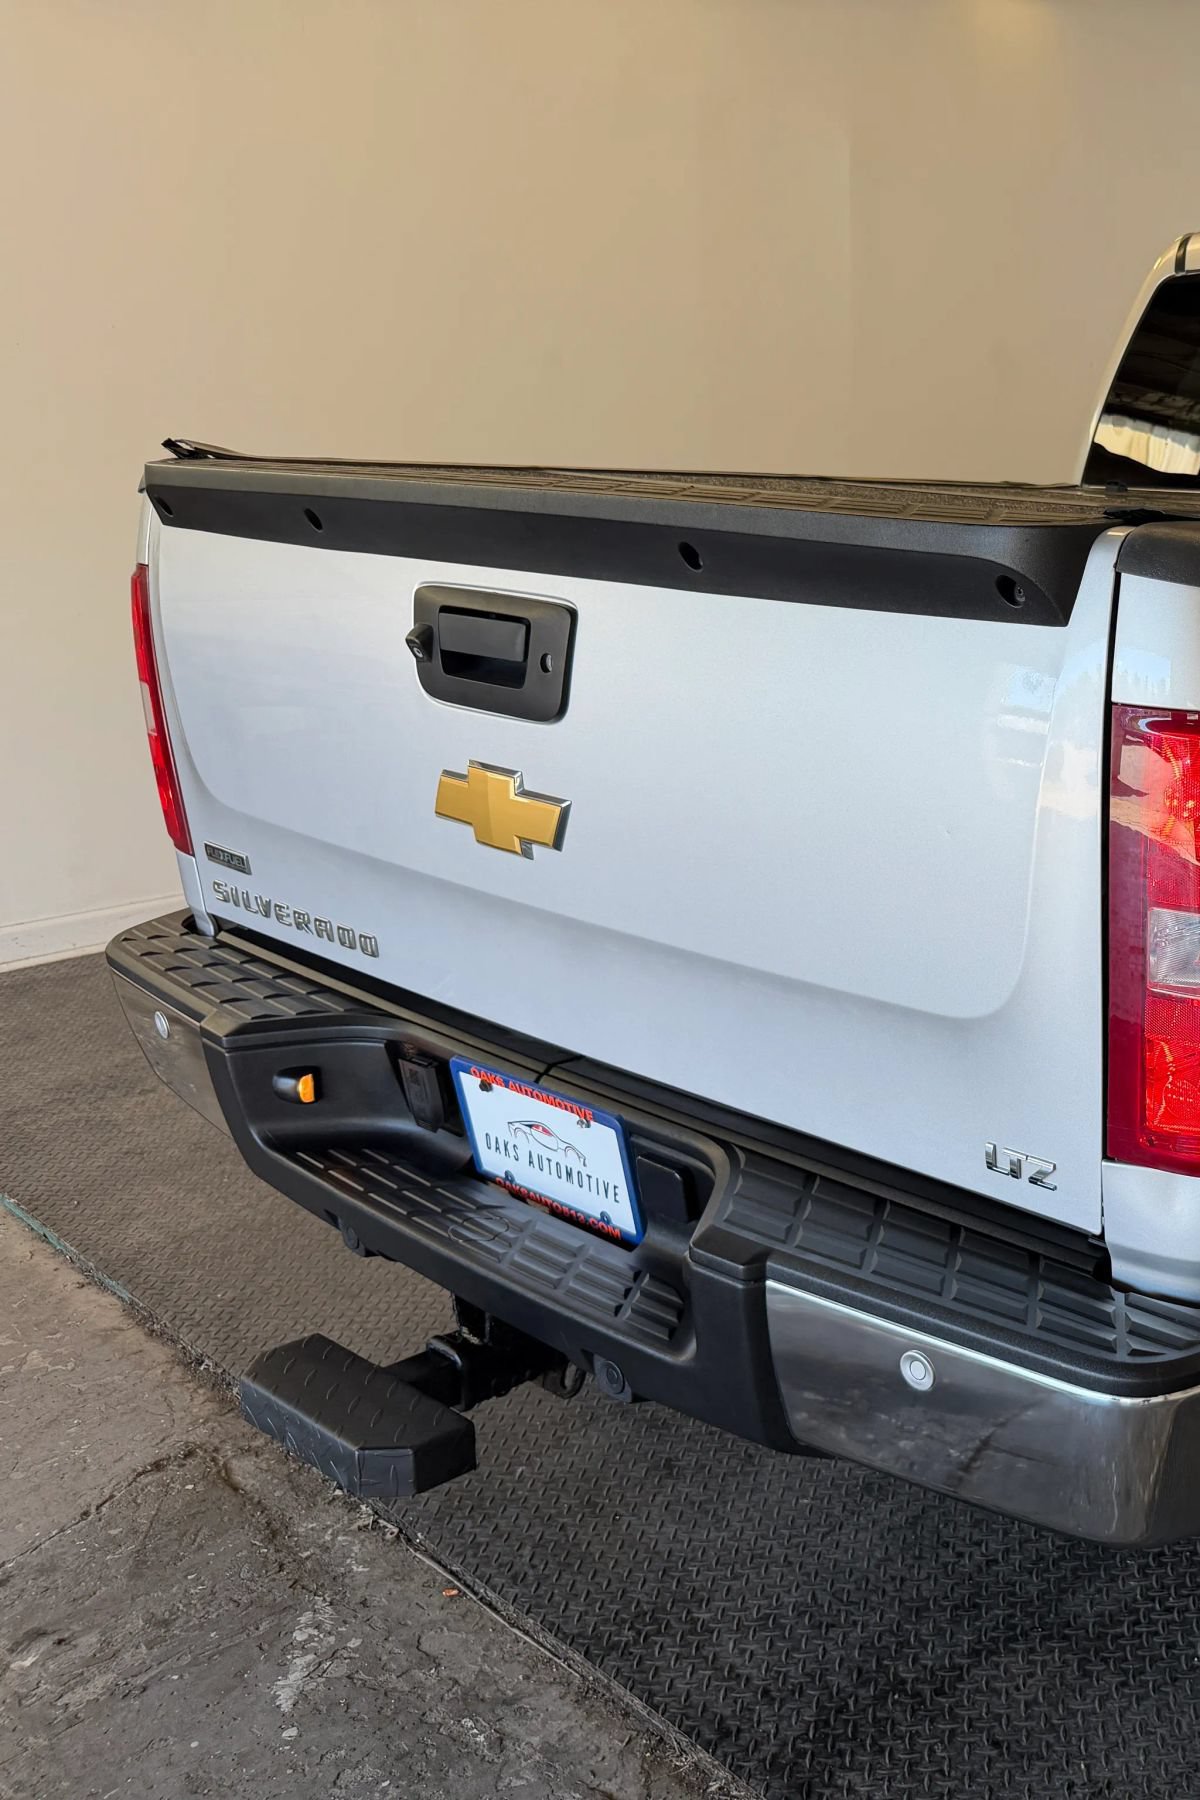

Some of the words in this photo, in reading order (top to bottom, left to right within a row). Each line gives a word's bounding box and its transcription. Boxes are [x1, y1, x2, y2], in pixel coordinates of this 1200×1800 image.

[213, 878, 379, 958] SILVERADO
[470, 1066, 505, 1088] OAKS
[508, 1080, 594, 1122] AUTOMOTIVE
[485, 1132, 520, 1161] OAKS
[528, 1150, 620, 1204] AUTOMOTIVE
[985, 1142, 1057, 1191] LTZ
